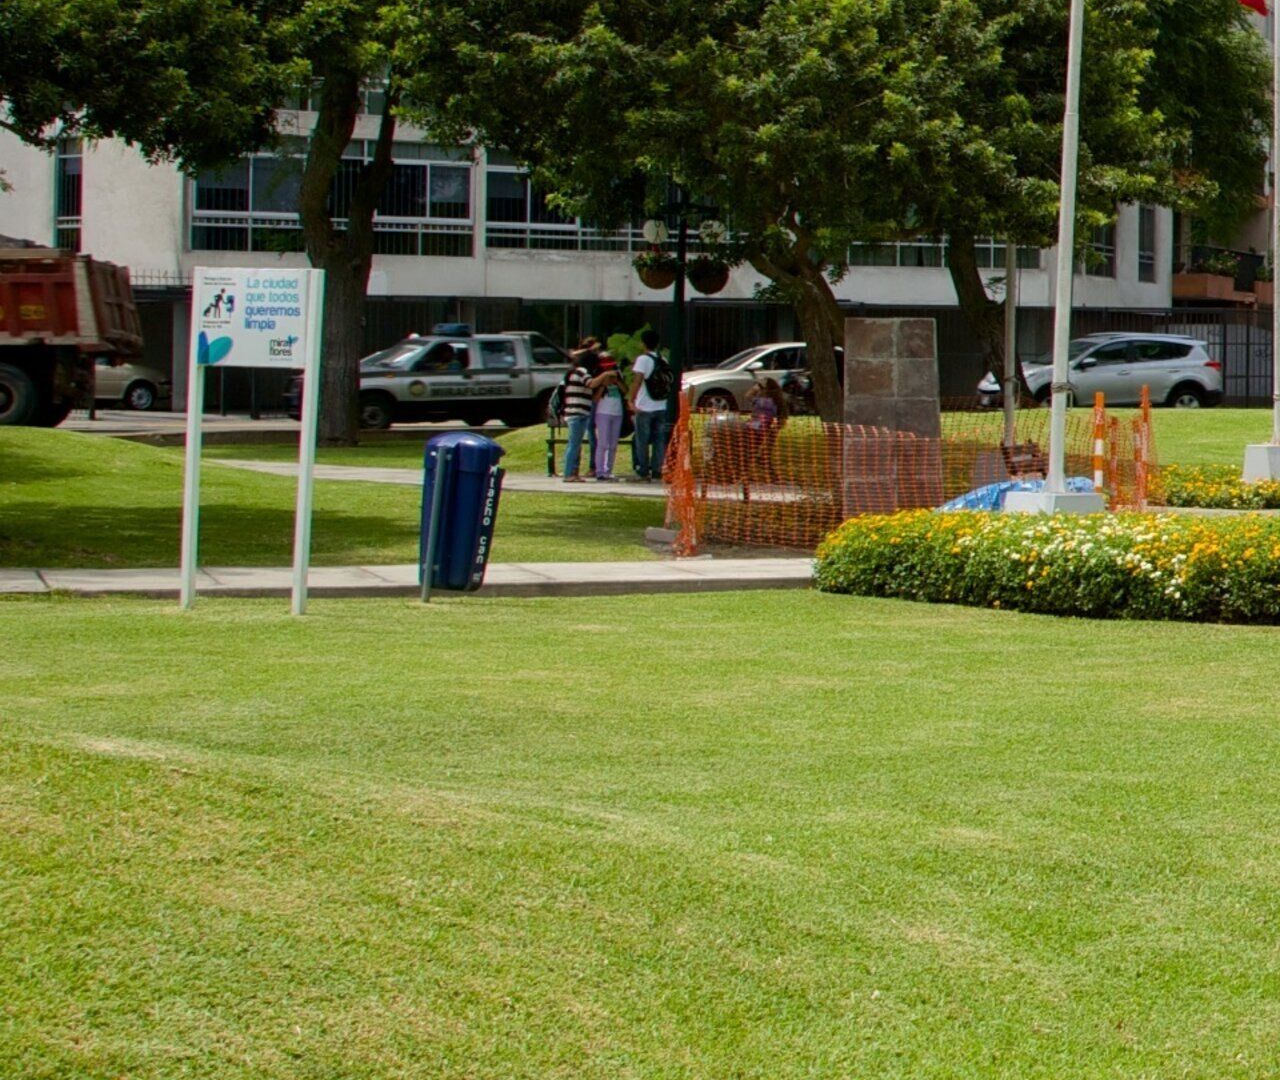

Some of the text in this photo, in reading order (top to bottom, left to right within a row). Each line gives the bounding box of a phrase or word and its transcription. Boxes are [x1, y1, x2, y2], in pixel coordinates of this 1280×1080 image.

[247, 277, 298, 289] La ciudad
[246, 292, 299, 304] que todos
[245, 306, 301, 318] queremos
[245, 318, 276, 332] limpia
